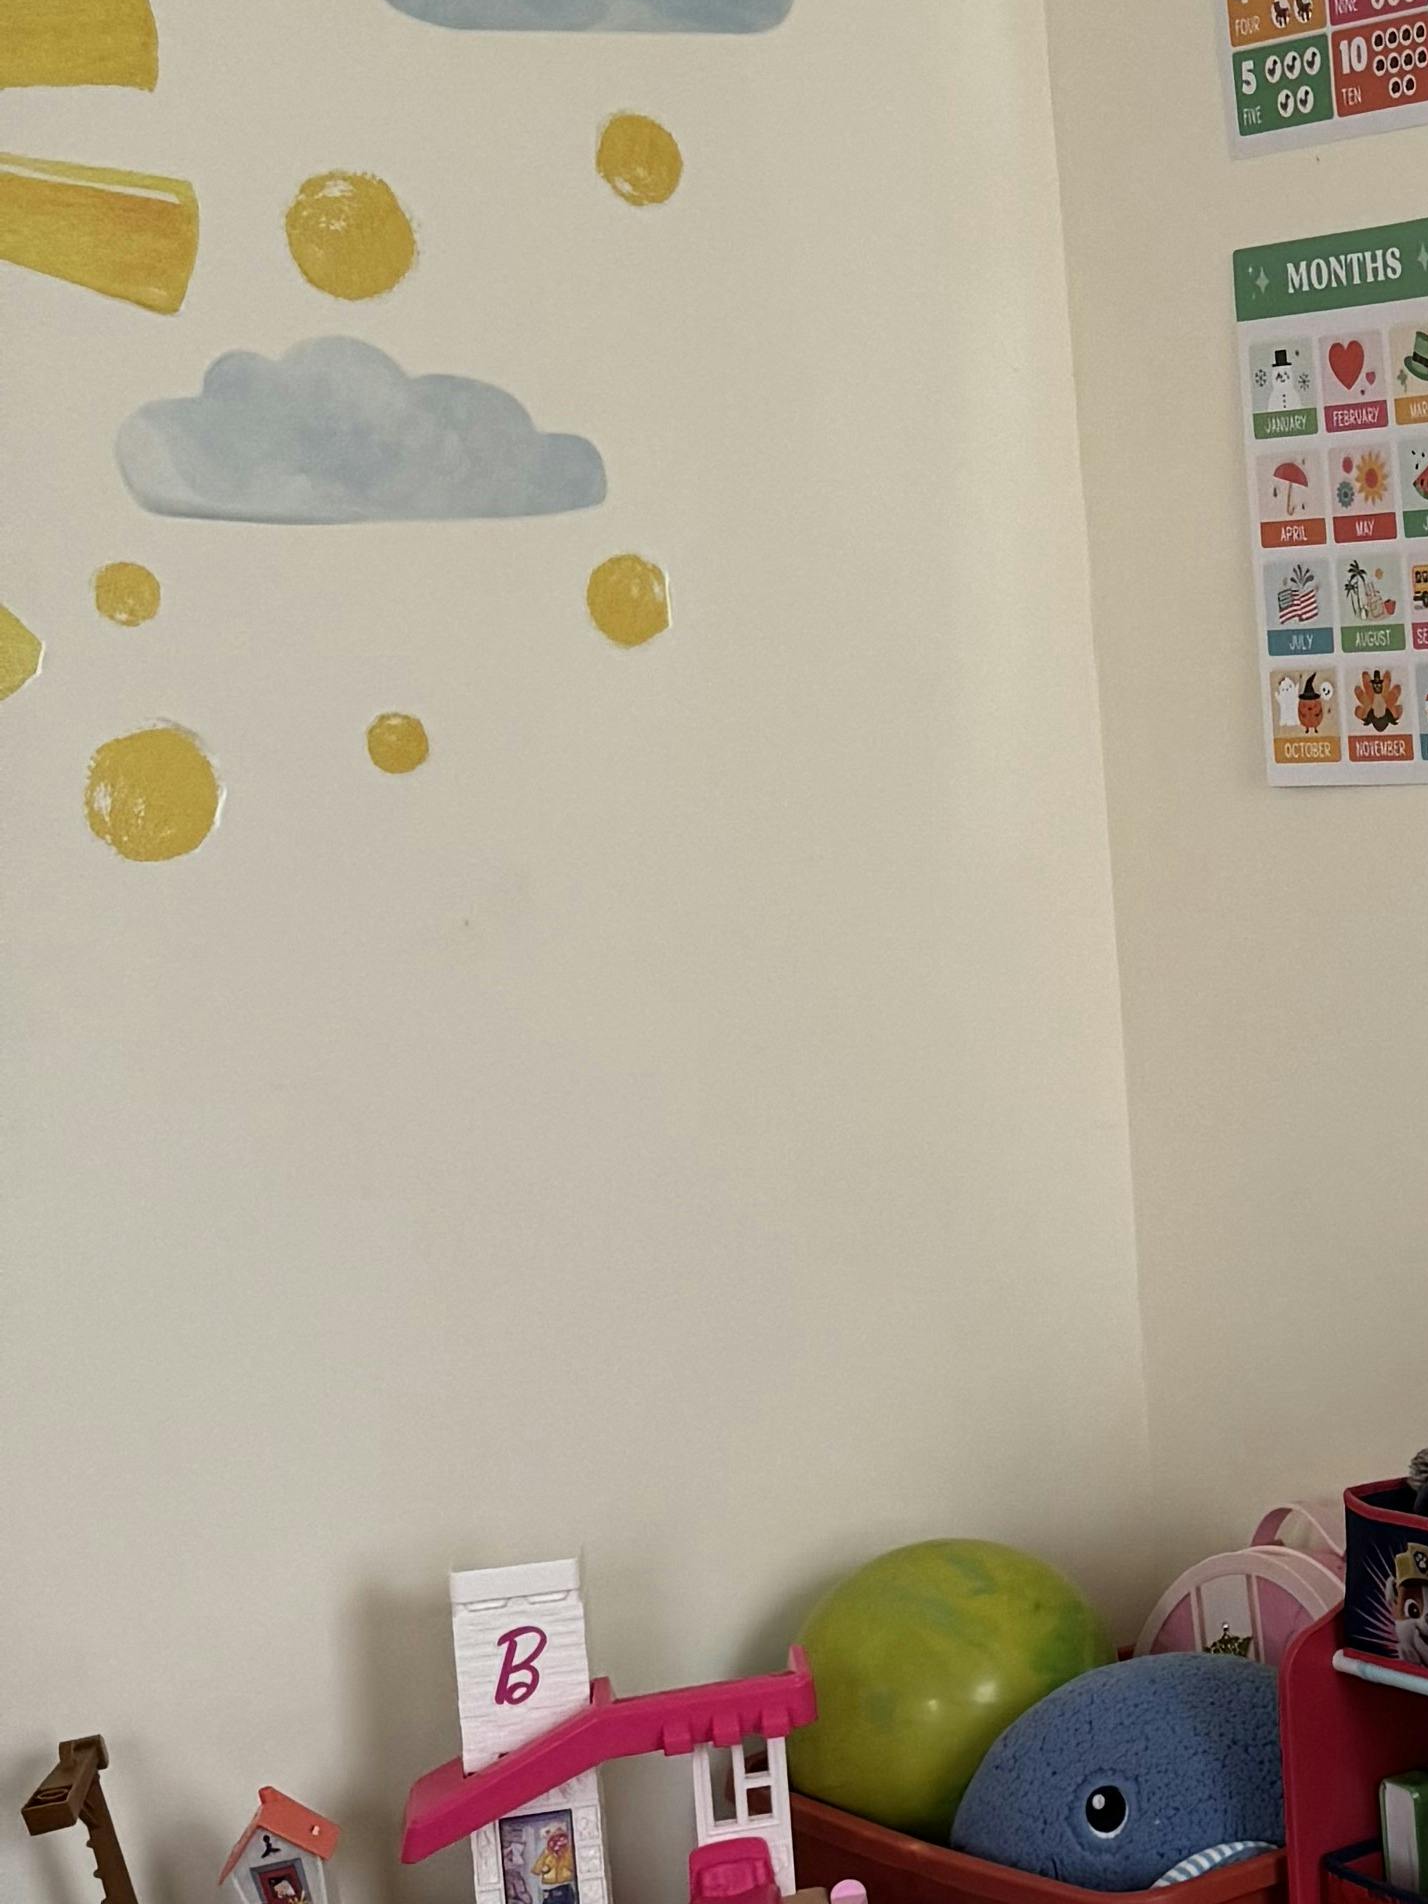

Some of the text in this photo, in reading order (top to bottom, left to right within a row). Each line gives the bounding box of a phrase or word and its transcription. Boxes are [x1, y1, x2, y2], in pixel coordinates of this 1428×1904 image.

[1234, 15, 1261, 37] FOUR
[1339, 36, 1368, 75] 10
[1241, 59, 1257, 95] 5
[1341, 86, 1362, 106] TEN
[1242, 105, 1263, 126] FIVE
[1286, 247, 1402, 294] MONTHS
[1265, 414, 1307, 434] JANUARY
[1332, 406, 1380, 427] FEBRUARY
[1280, 525, 1308, 542] APRIL
[1355, 519, 1375, 537] MAY
[1288, 633, 1314, 651] JULY
[1355, 629, 1392, 647] AUGUST
[1284, 741, 1332, 759] OCTOBER
[1355, 739, 1406, 757] NOVEMBER
[494, 1625, 548, 1706] B
